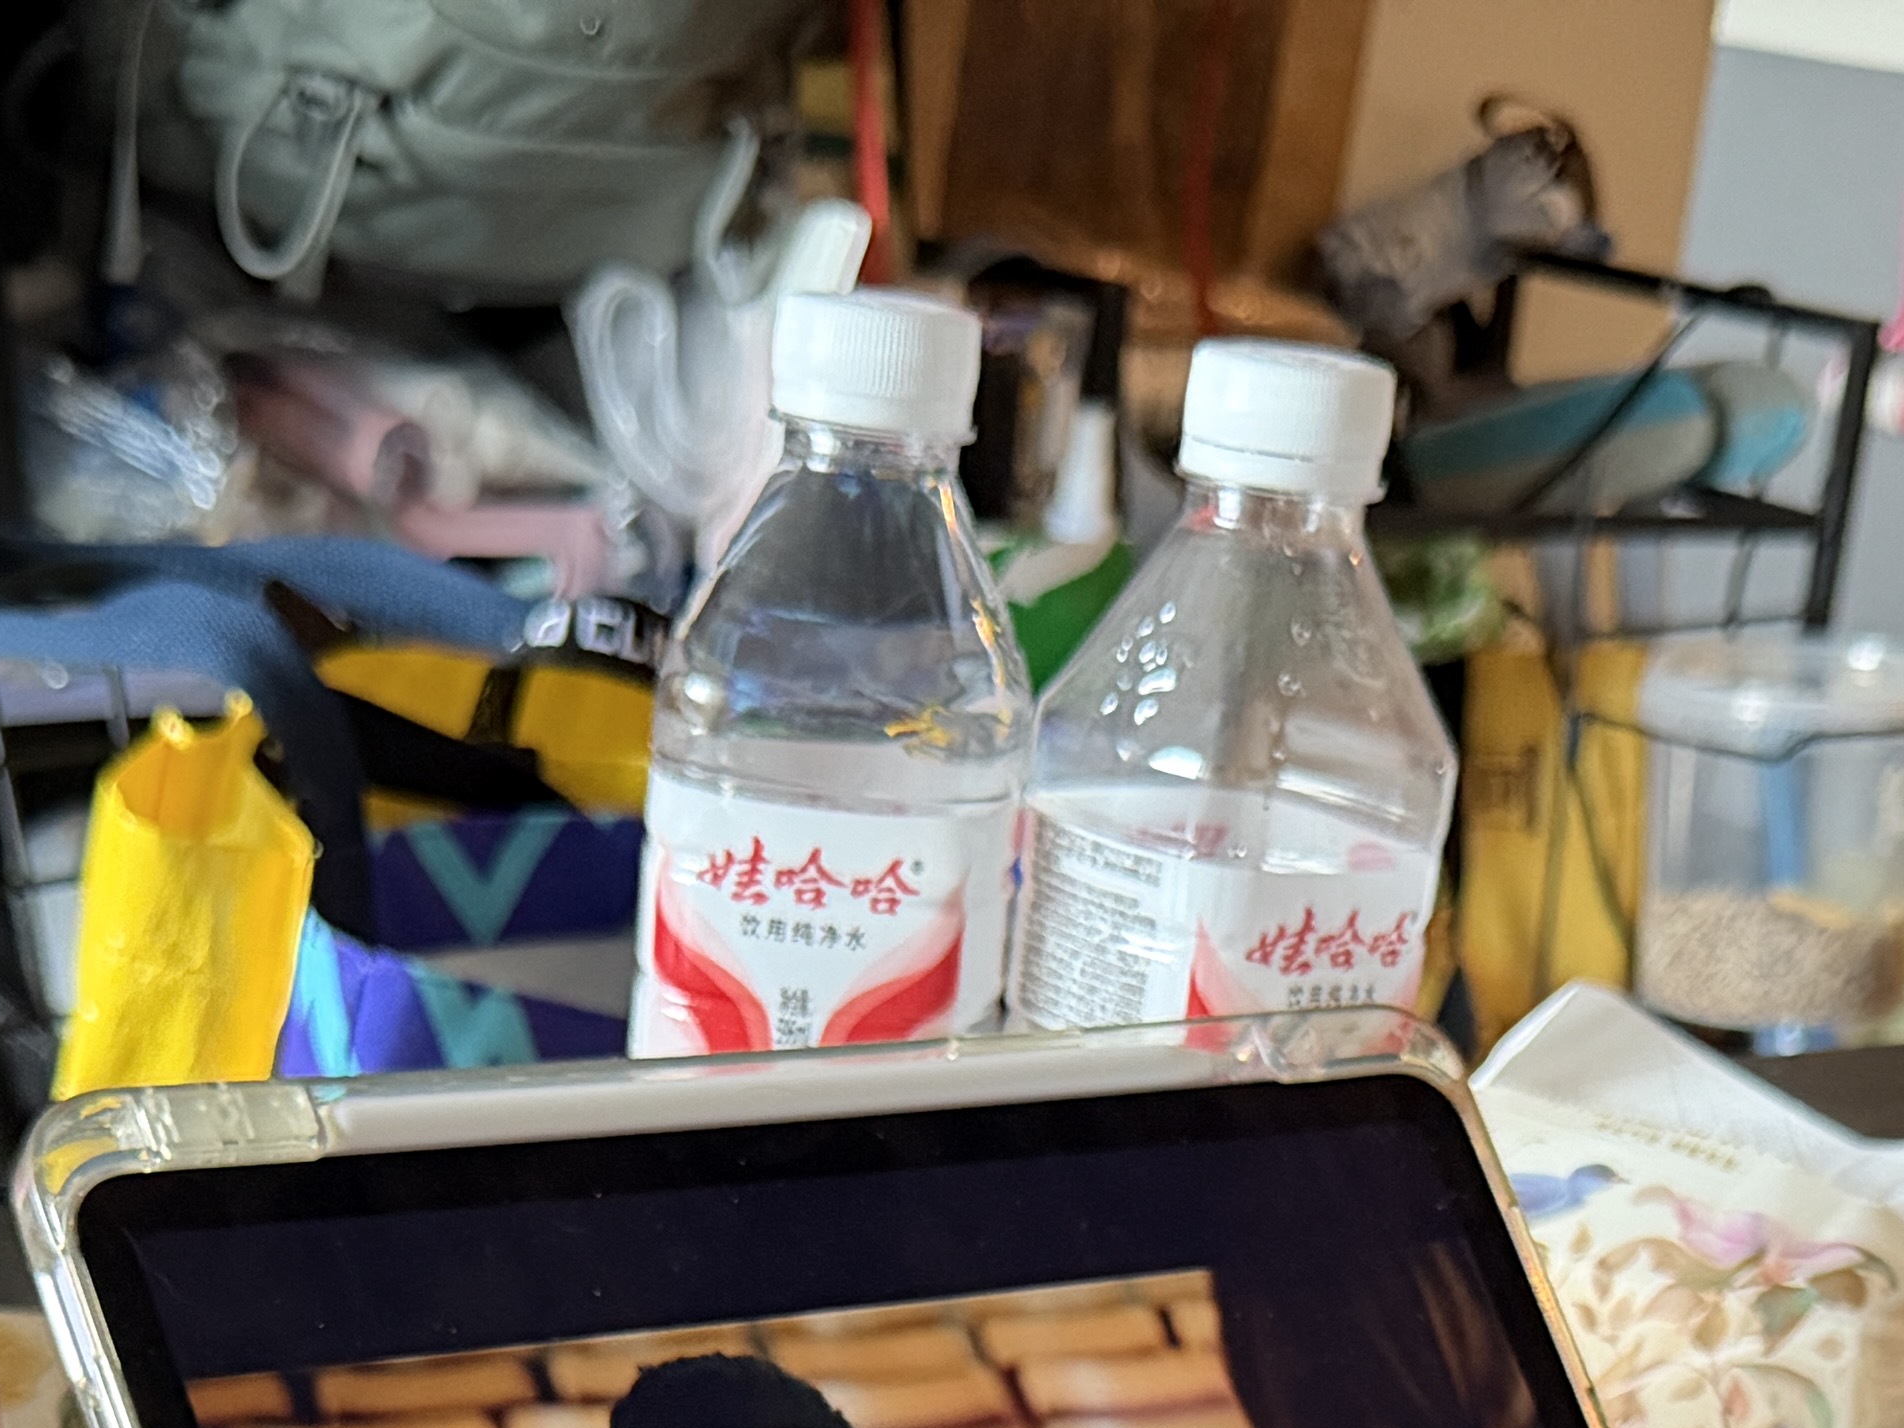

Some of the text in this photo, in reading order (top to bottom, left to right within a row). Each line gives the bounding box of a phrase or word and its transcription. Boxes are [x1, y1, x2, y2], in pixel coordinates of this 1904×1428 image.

[697, 831, 919, 916] 娃哈哈
[738, 912, 866, 953] 饮用纯净水
[1244, 904, 1408, 977] 娃哈哈
